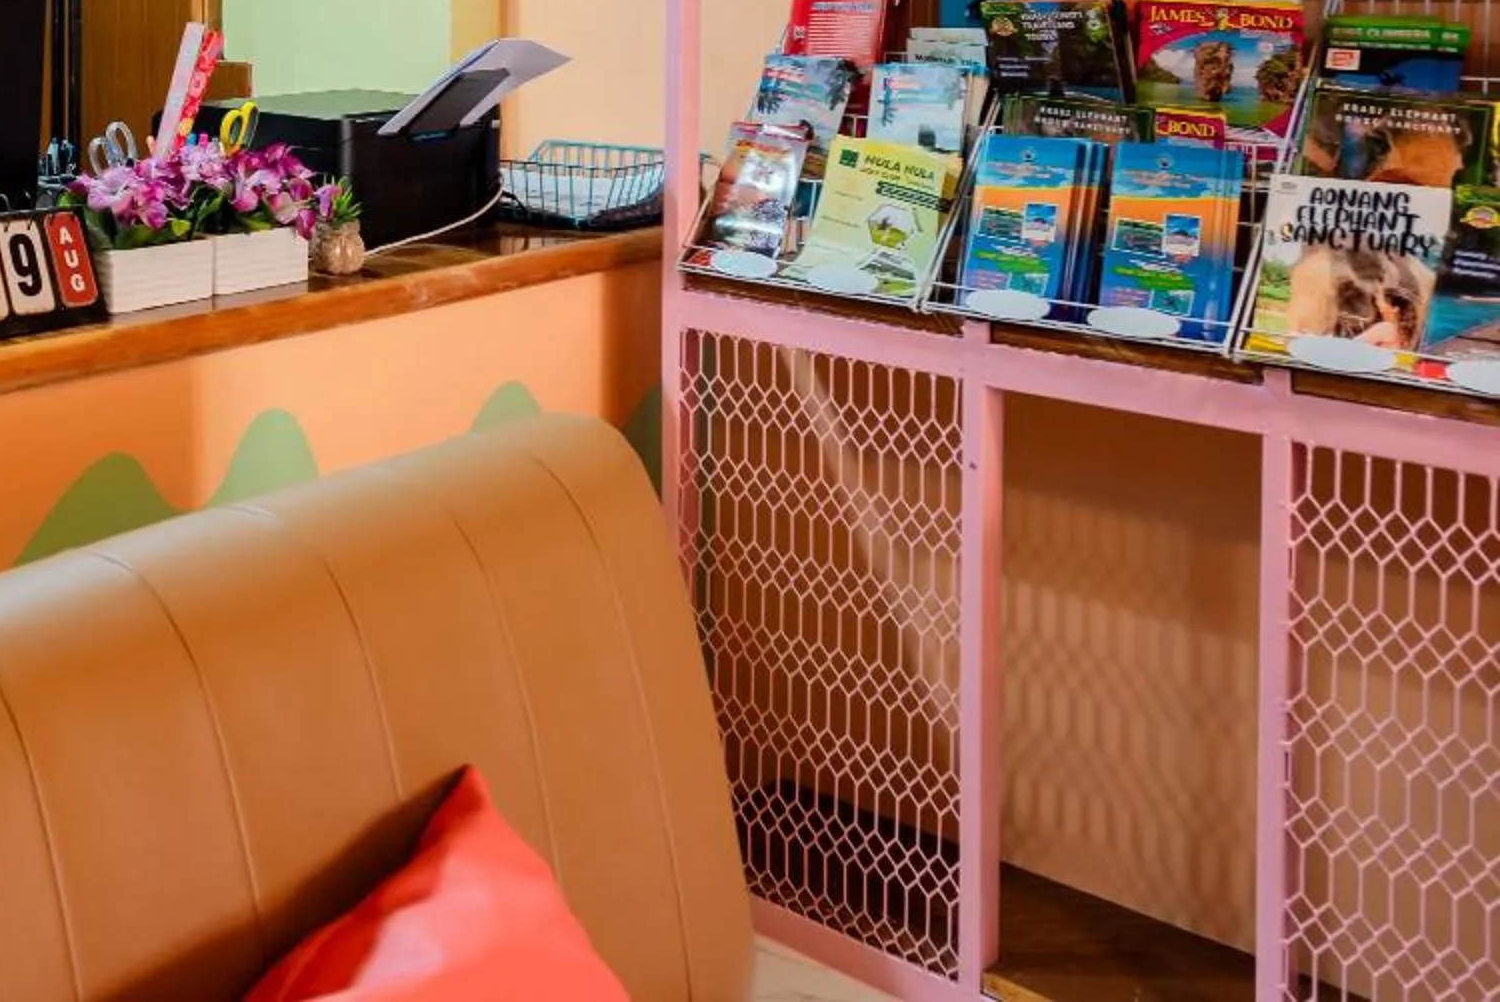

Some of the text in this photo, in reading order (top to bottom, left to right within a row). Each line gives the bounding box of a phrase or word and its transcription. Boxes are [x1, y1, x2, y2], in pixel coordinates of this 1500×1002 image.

[1150, 6, 1293, 30] JAMES BOND
[1389, 107, 1457, 123] ELEPHANT
[1166, 120, 1216, 138] BOND
[1309, 187, 1411, 213] AONANG
[1296, 205, 1421, 234] ELEPHANT
[1280, 222, 1433, 259] SANCTUARY
[59, 227, 86, 293] AUG
